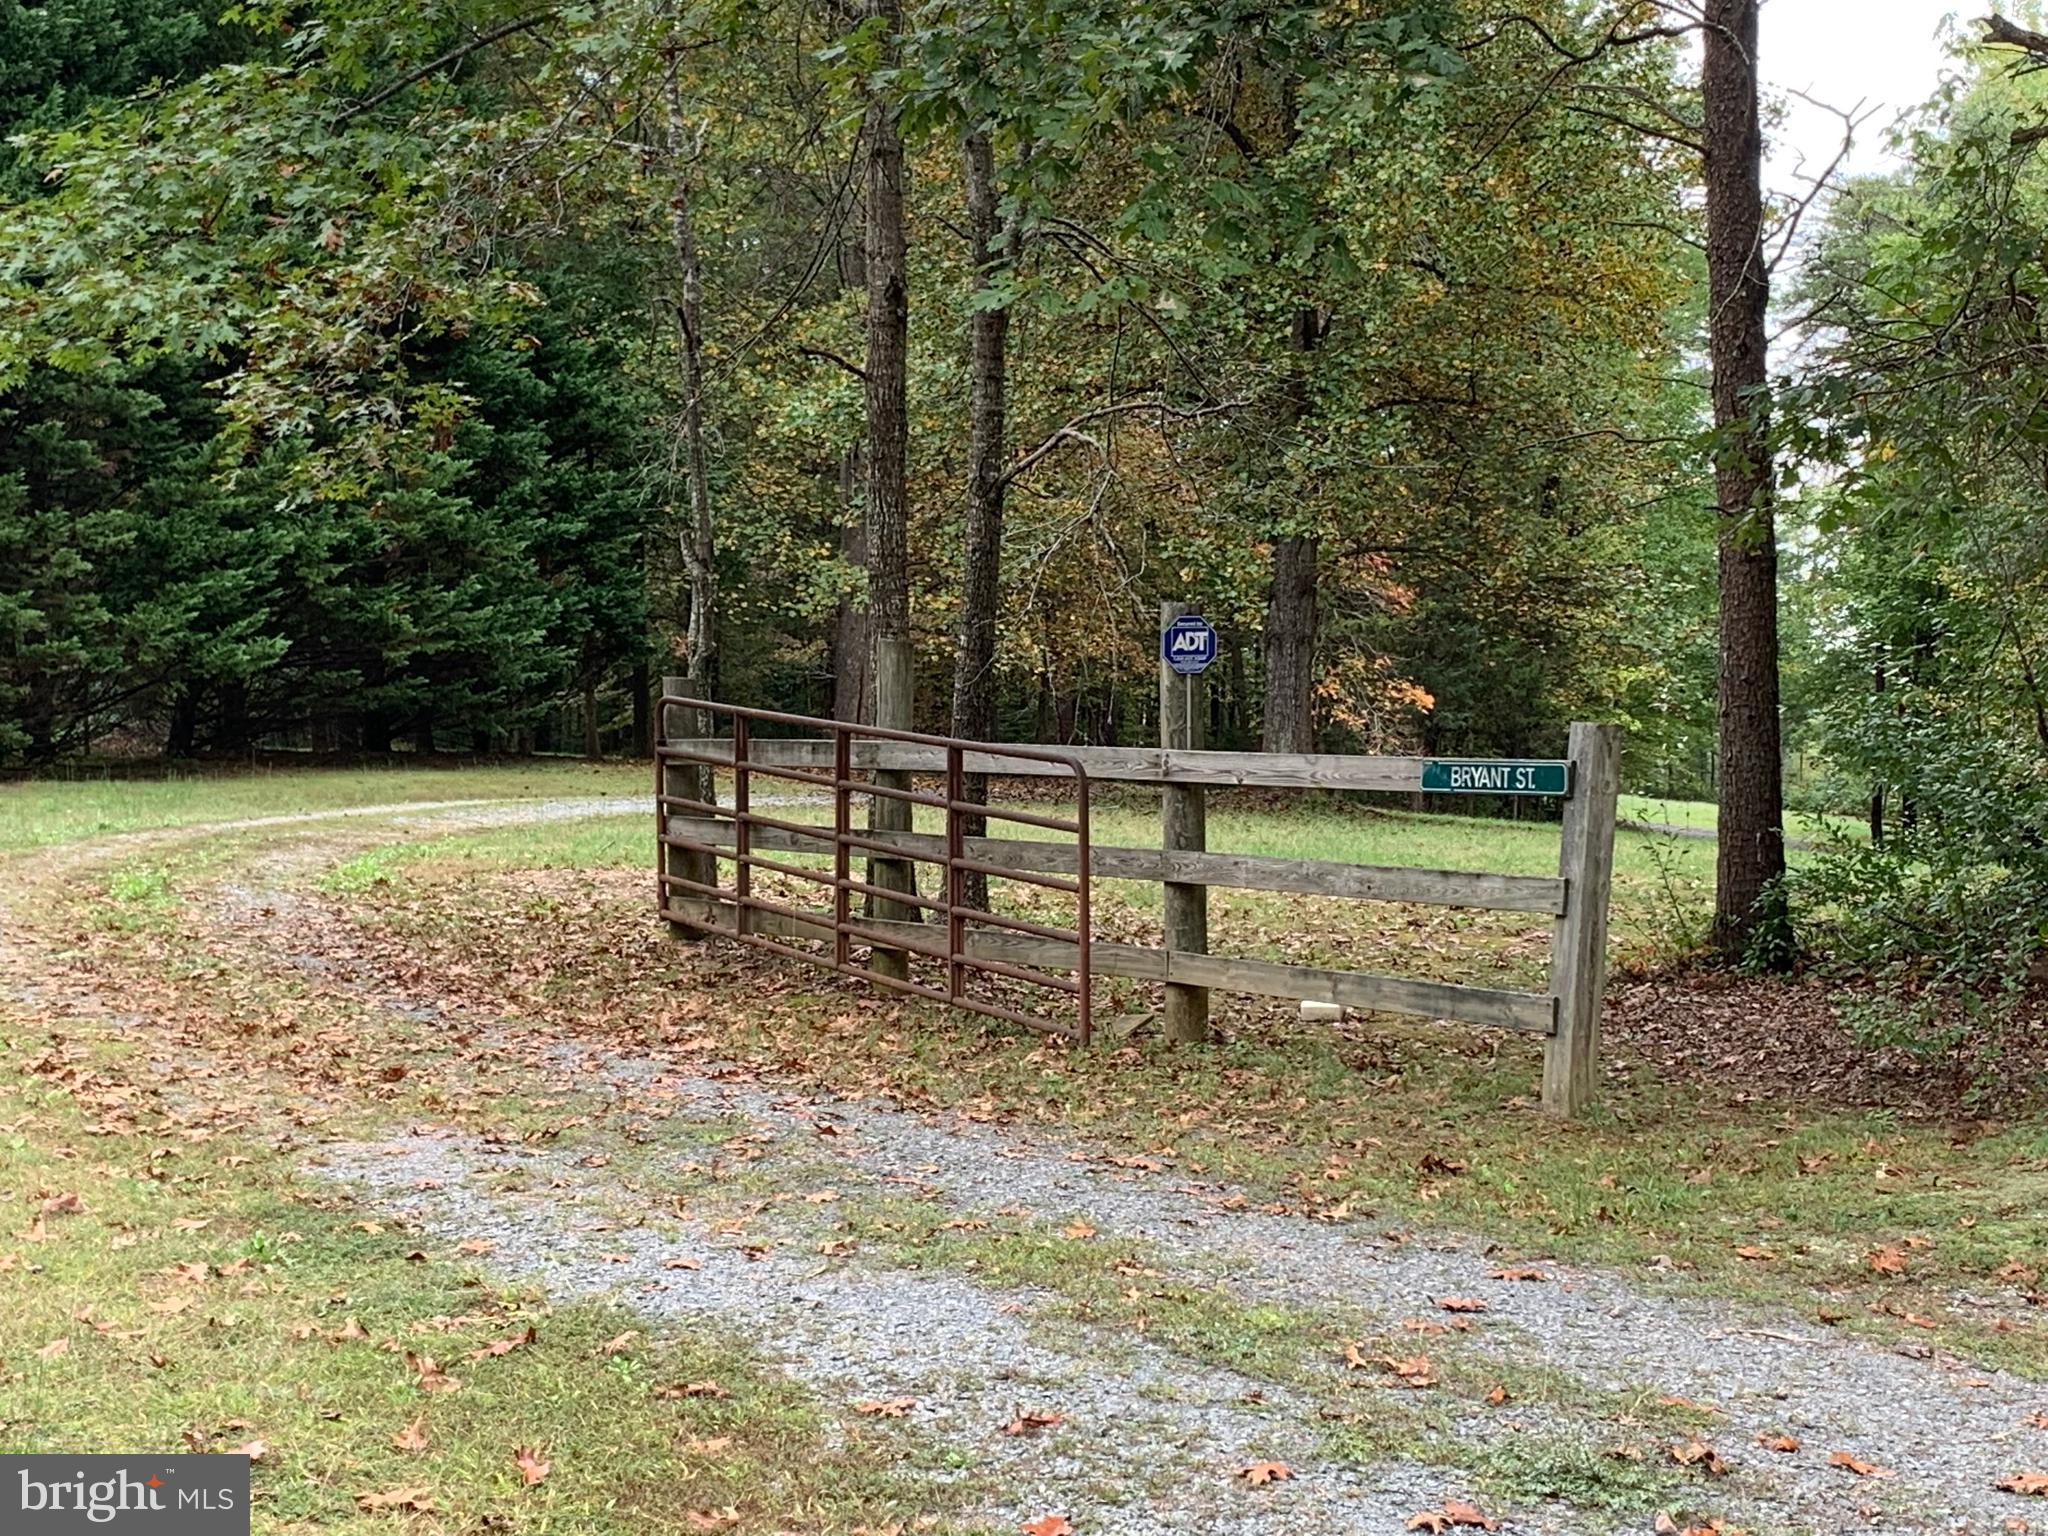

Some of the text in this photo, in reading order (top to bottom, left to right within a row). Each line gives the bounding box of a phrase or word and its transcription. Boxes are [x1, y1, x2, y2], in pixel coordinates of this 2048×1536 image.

[1172, 631, 1209, 651] ADT
[1450, 766, 1536, 789] BRYANT ST.
